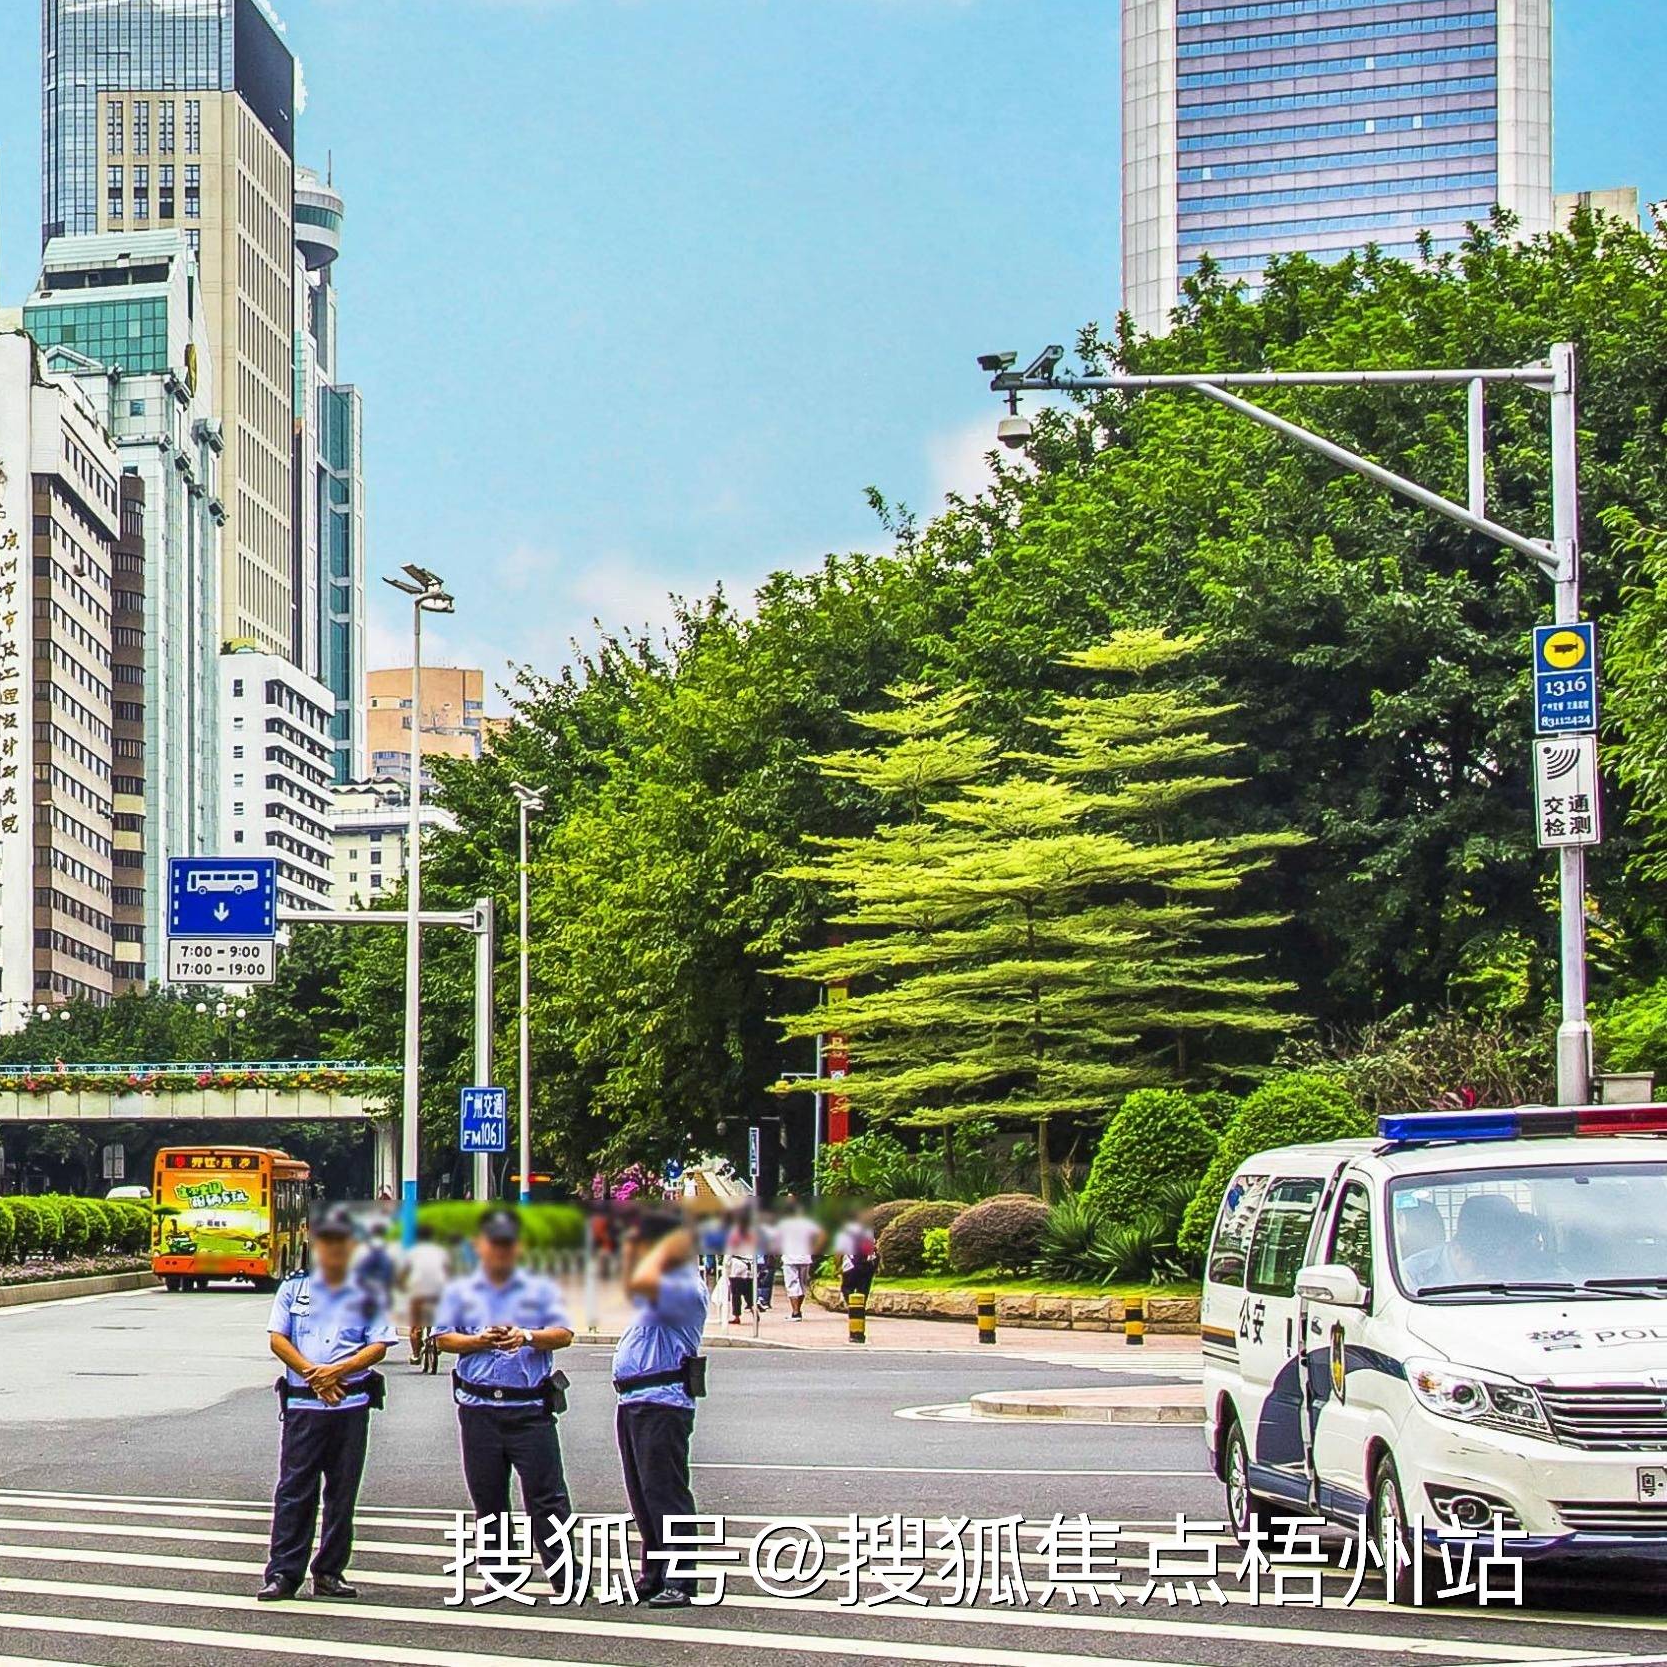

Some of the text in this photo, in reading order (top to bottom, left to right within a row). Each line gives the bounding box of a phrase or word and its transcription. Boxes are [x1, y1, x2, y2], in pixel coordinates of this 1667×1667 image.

[1545, 676, 1587, 697] 1316
[1543, 793, 1589, 815] 交通
[1544, 815, 1591, 837] 检测
[463, 1092, 503, 1119] 广州交通
[1239, 1296, 1266, 1346] 公安
